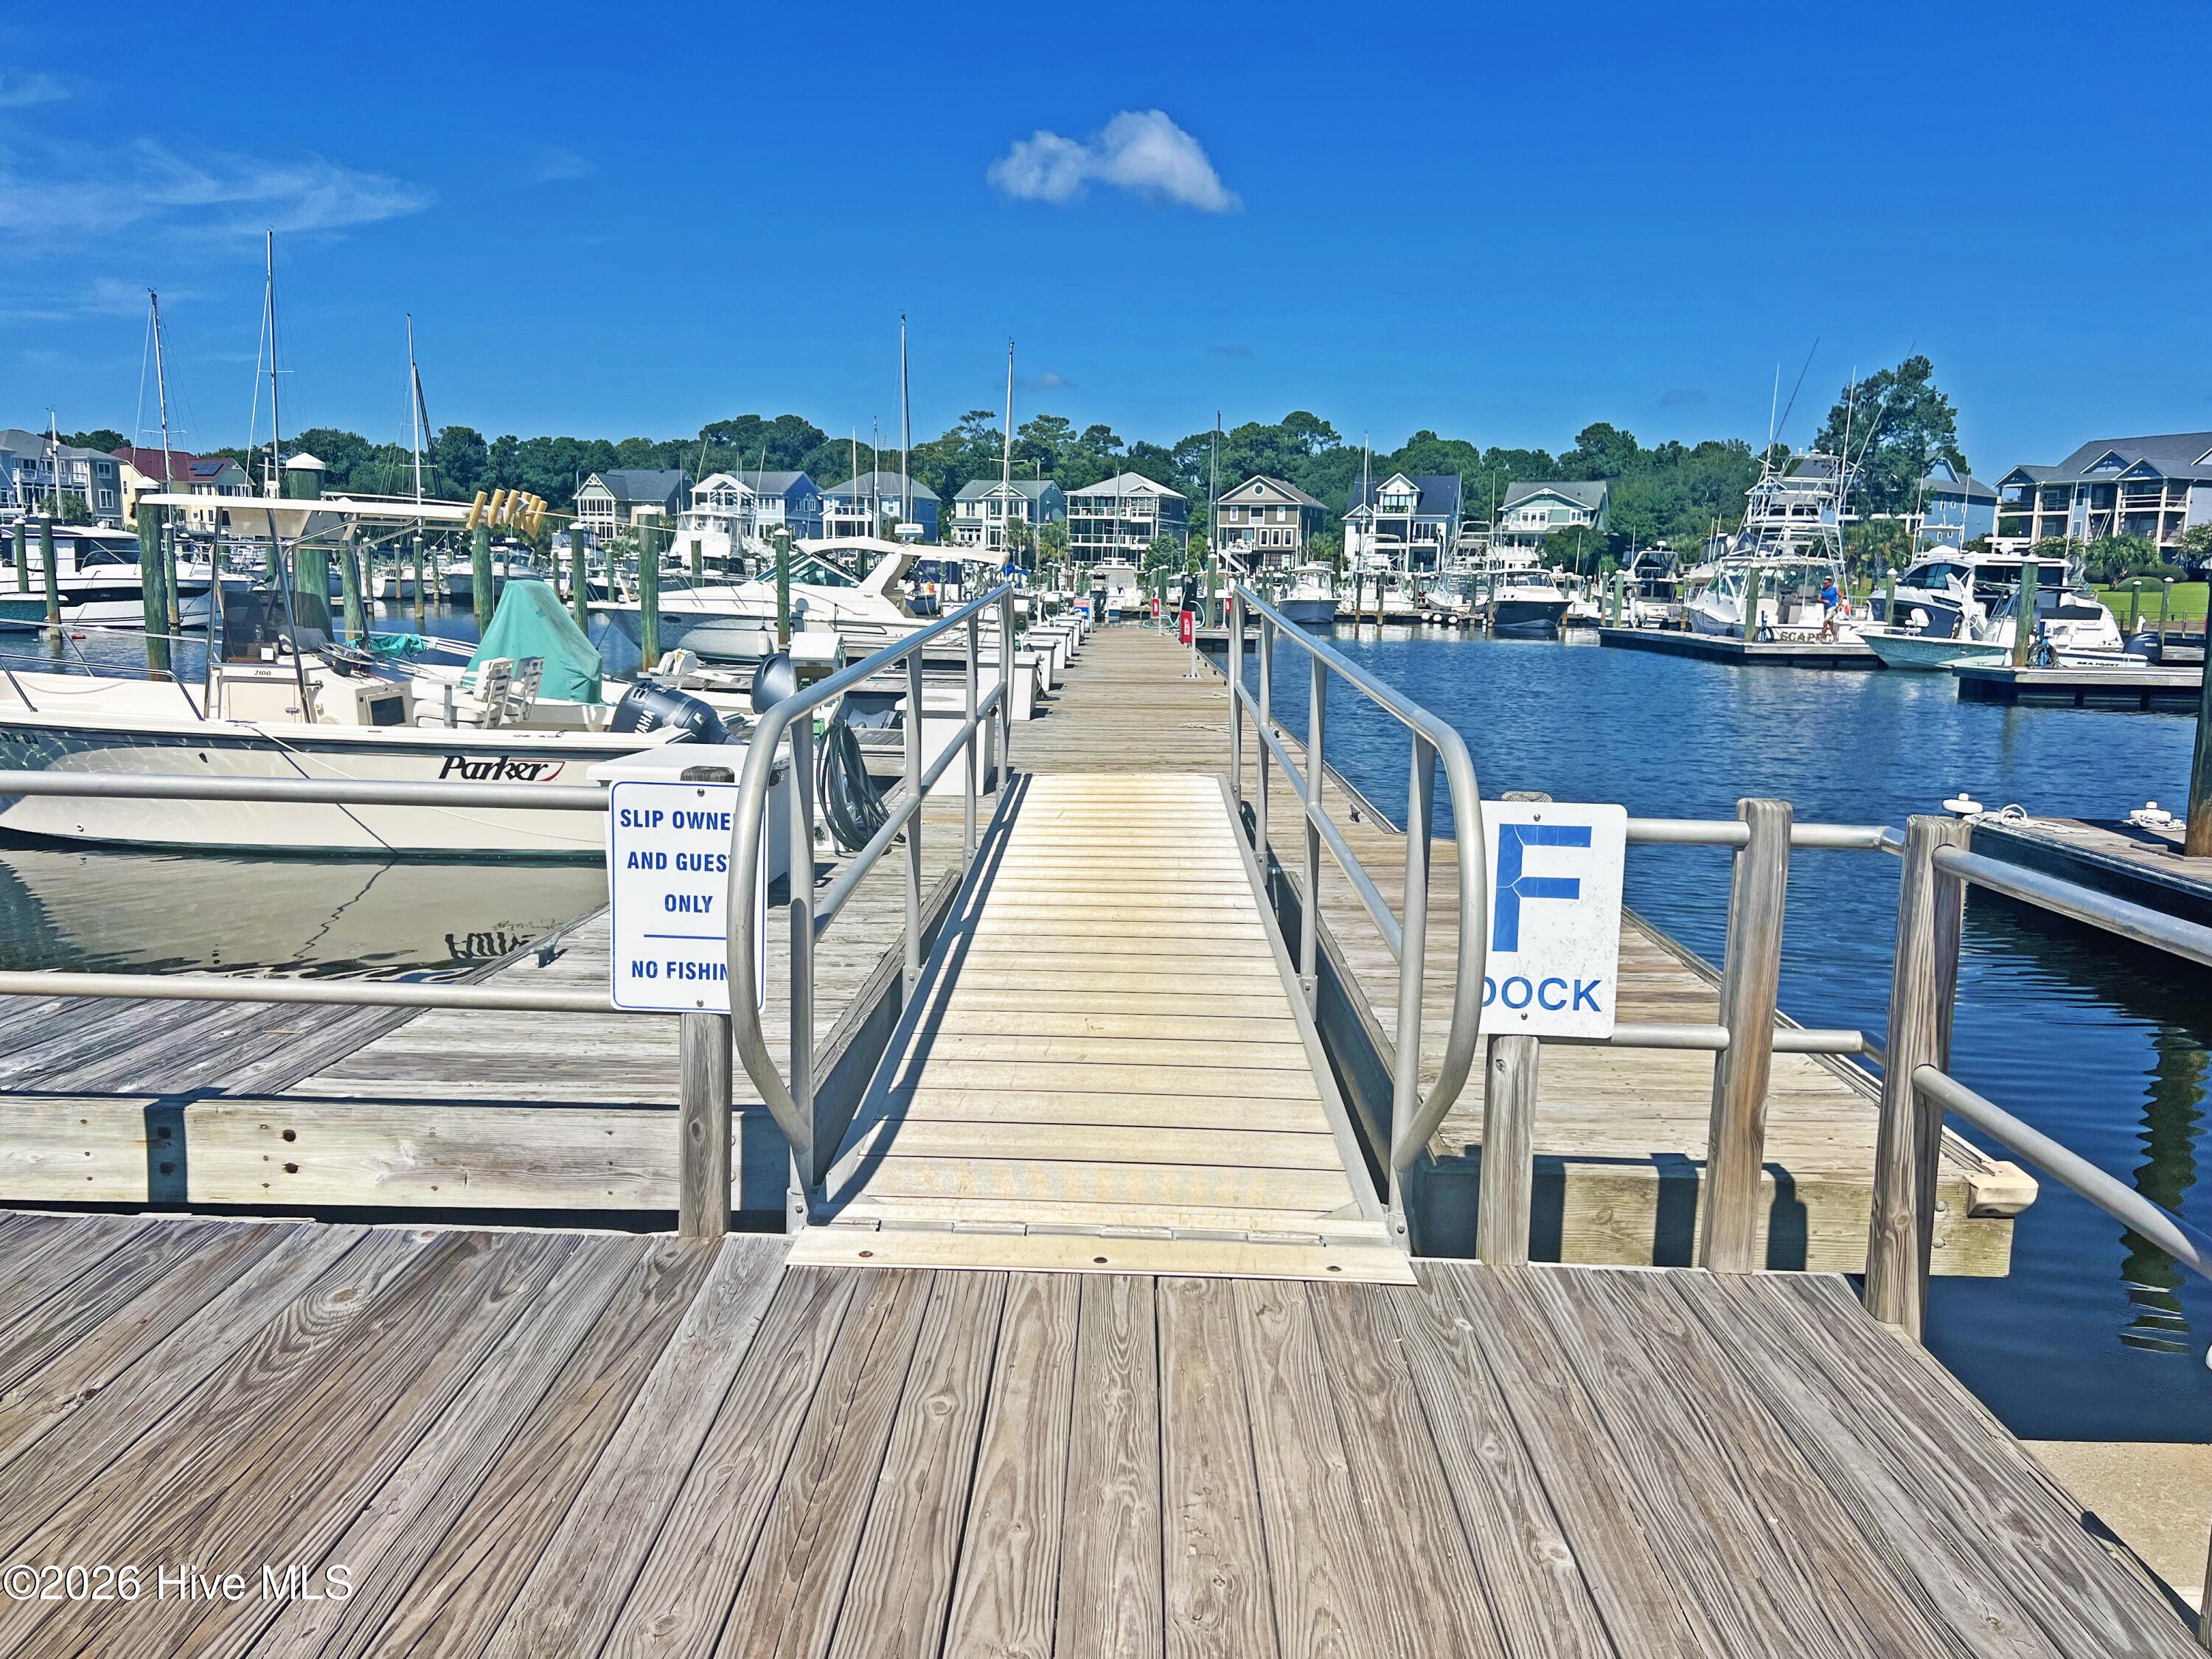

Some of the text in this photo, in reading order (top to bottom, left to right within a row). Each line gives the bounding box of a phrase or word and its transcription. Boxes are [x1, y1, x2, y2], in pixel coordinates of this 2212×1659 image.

[439, 755, 549, 782] Parker
[620, 809, 735, 831] SLIP OWNE
[627, 852, 730, 872] AND GUES
[1492, 824, 1592, 953] F
[664, 894, 714, 913] ONLY
[632, 960, 658, 978] NO
